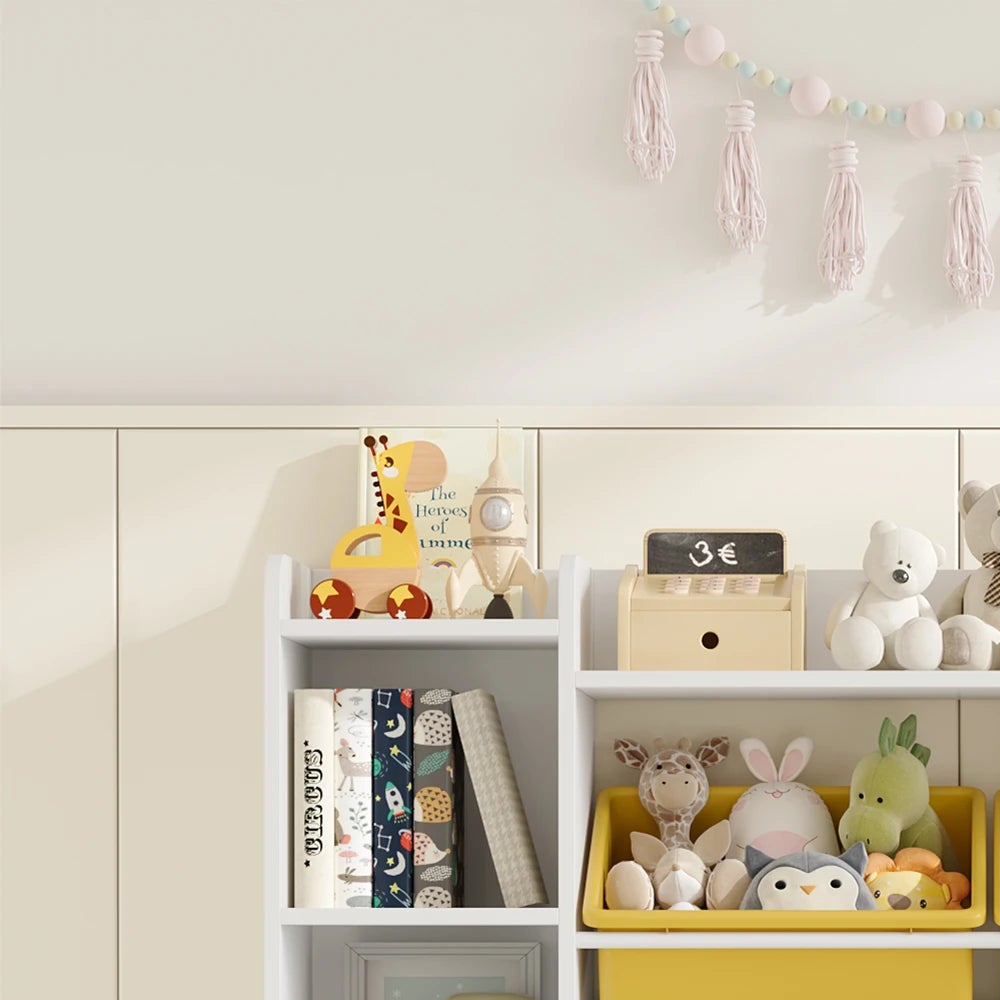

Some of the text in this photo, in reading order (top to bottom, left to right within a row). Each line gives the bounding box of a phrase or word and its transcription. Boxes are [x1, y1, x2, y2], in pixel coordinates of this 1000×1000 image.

[431, 485, 457, 501] The
[416, 504, 468, 518] Heroes
[431, 517, 450, 534] of
[303, 749, 324, 856] CIRCUS
